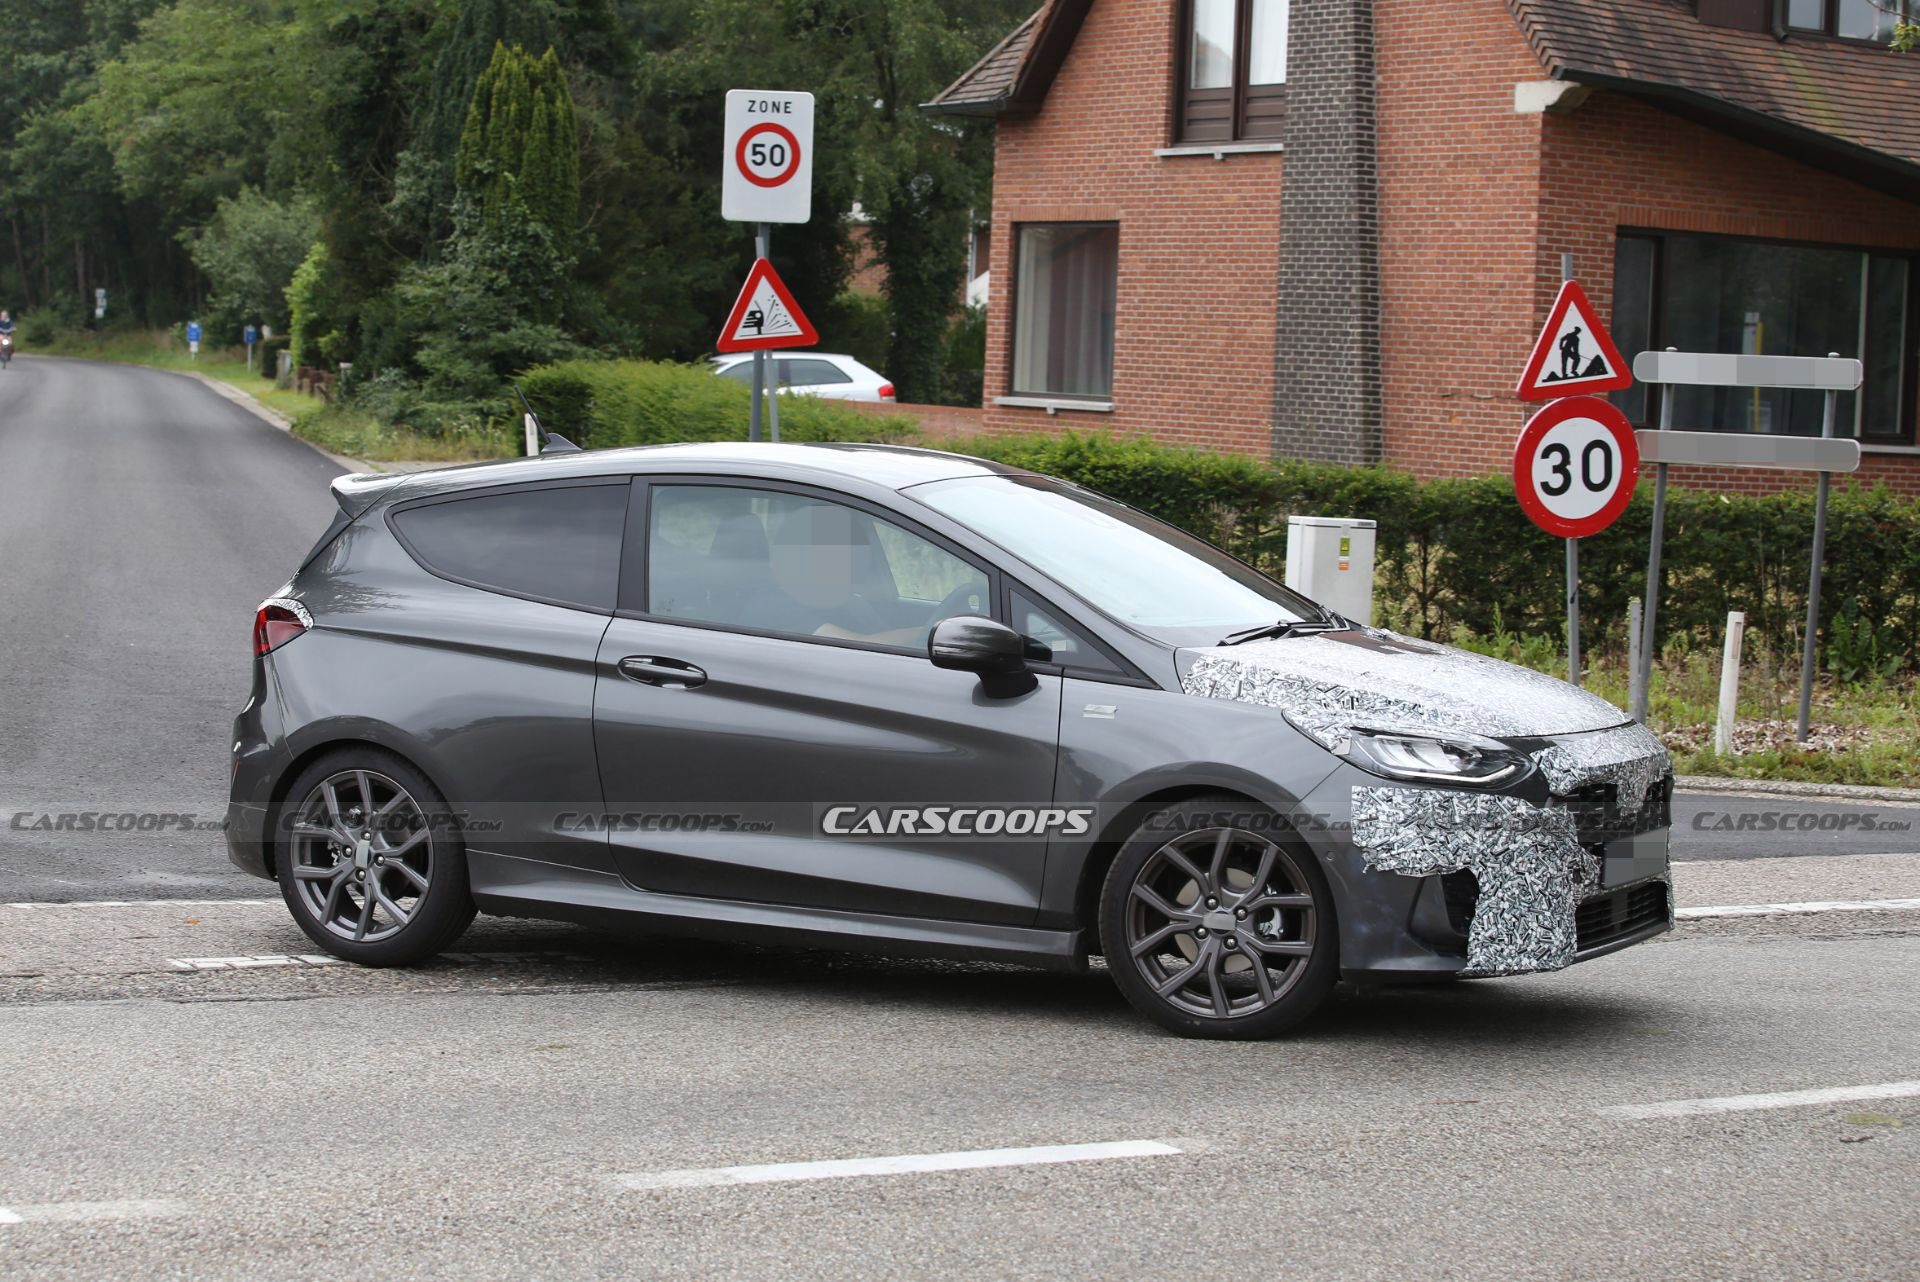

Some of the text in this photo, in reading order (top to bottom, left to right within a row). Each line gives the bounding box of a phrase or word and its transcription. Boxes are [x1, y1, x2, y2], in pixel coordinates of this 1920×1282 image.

[747, 99, 792, 114] ZONE
[751, 143, 785, 167] 50
[1540, 439, 1613, 496] 30
